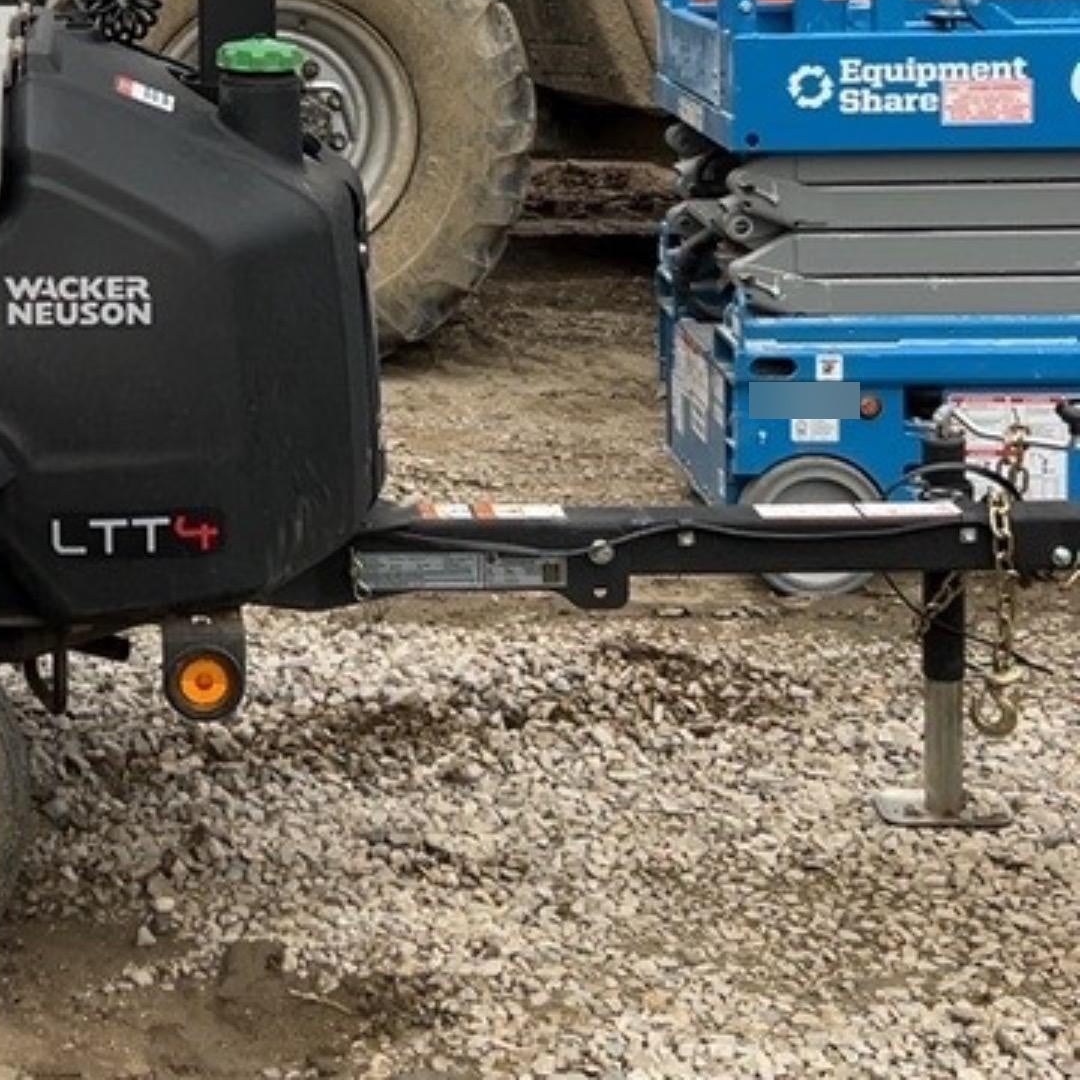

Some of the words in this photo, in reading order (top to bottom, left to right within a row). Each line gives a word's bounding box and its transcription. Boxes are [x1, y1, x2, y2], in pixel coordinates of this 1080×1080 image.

[839, 56, 1027, 88] Equipment
[839, 88, 939, 114] Share
[5, 276, 150, 300] WACKER
[7, 301, 152, 325] NEUSON
[50, 516, 219, 556] LTT4
